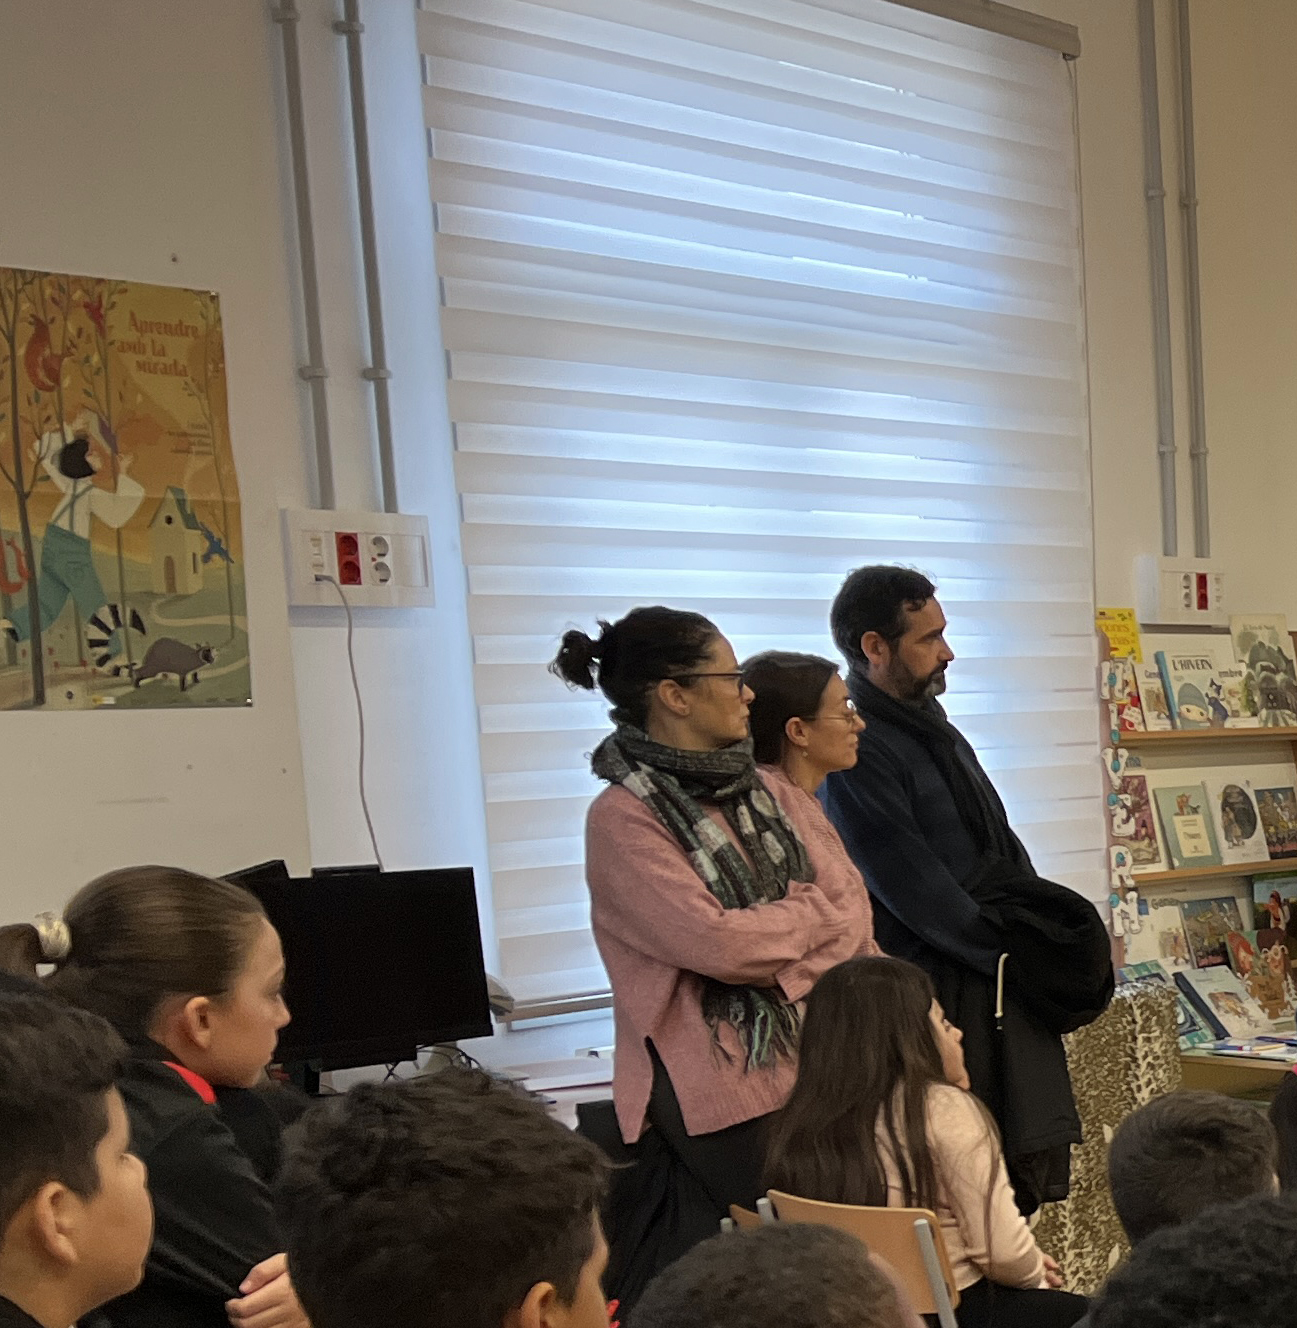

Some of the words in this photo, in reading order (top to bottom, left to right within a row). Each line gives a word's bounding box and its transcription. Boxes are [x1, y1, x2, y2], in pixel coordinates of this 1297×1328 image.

[130, 311, 199, 337] Aprendre
[152, 339, 165, 357] la
[136, 360, 188, 377] mirada
